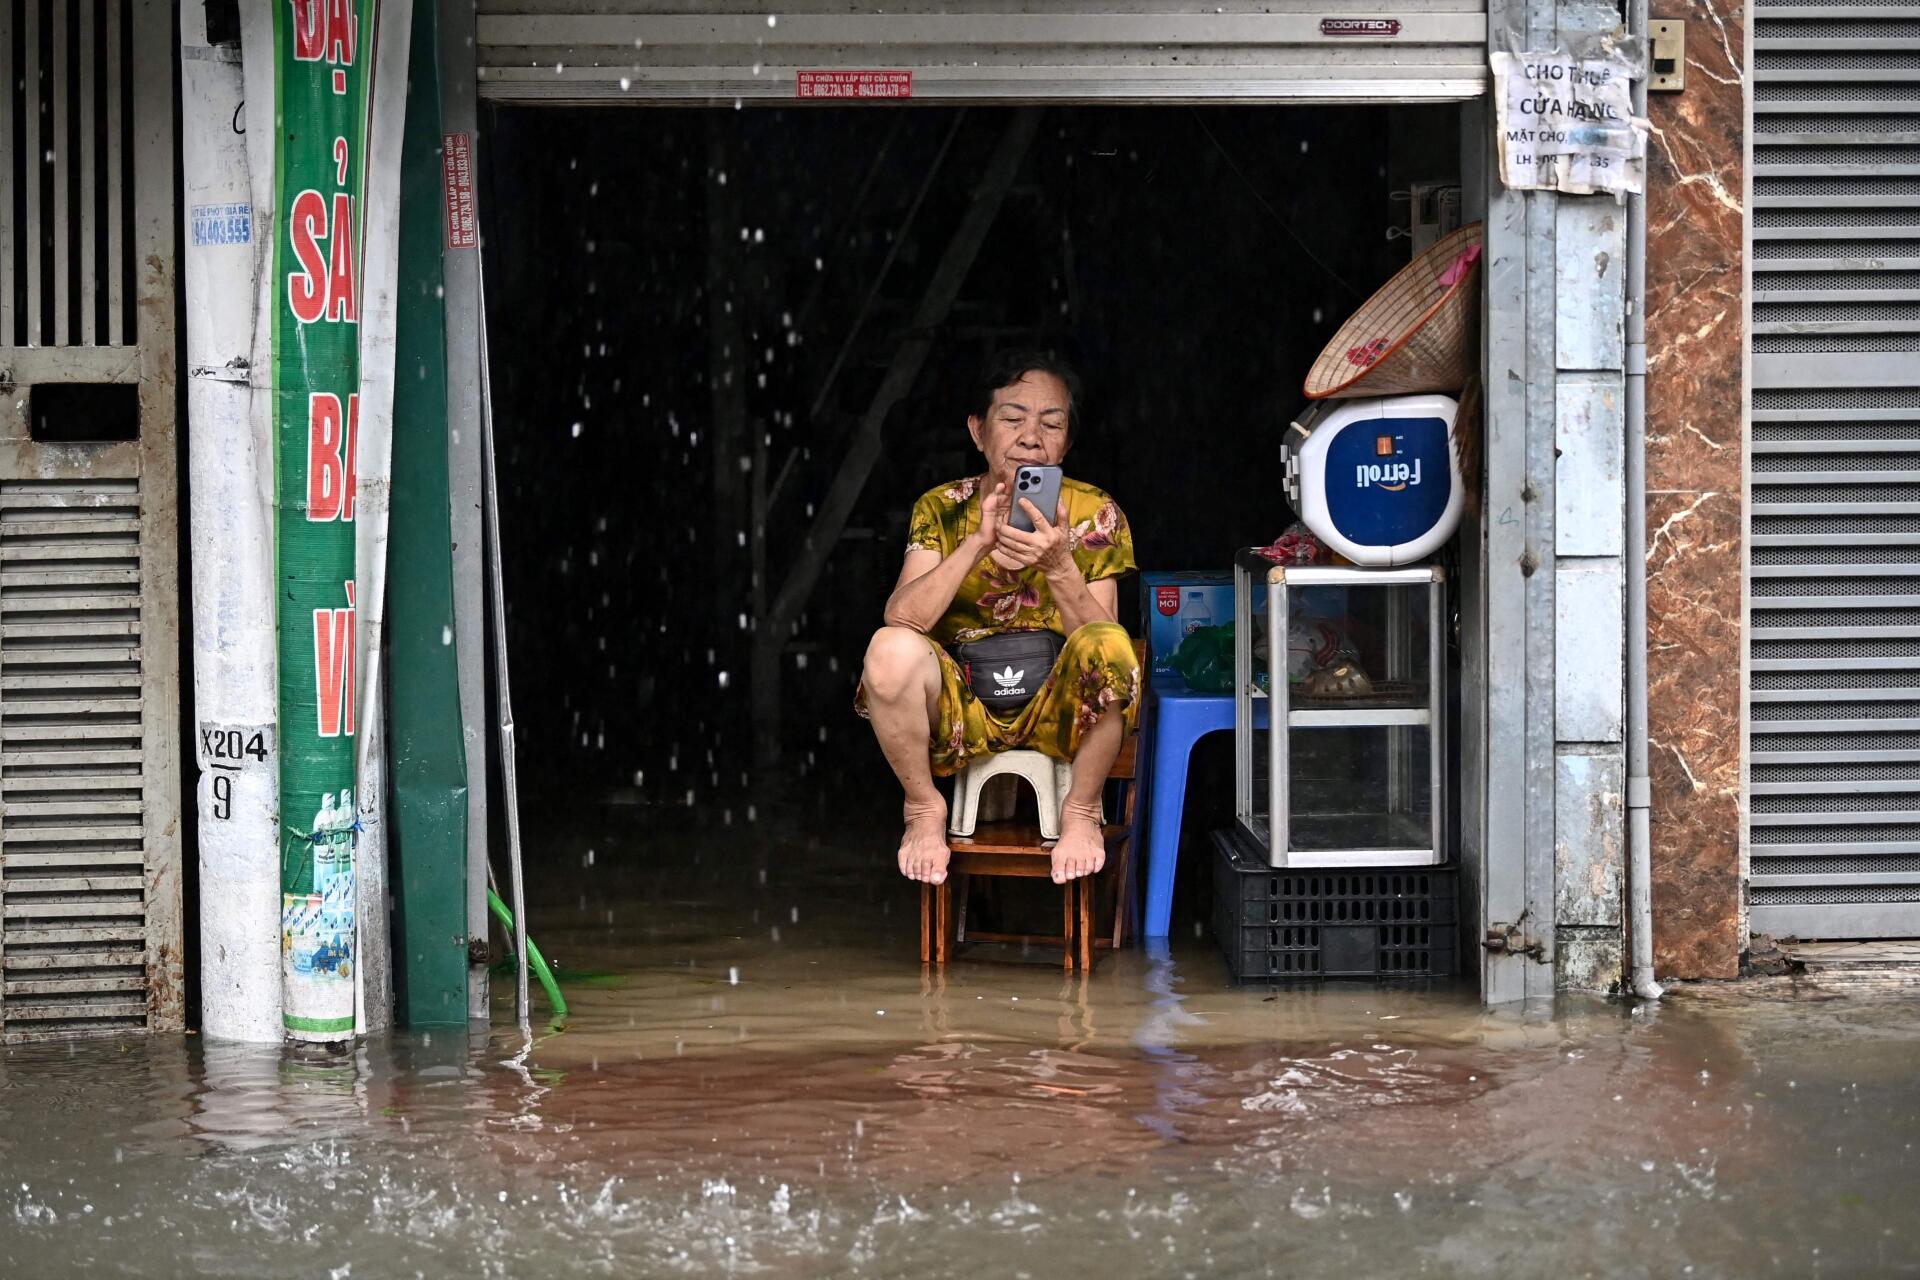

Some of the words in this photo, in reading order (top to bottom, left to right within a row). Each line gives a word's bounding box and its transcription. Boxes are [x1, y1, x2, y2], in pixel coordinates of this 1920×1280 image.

[1326, 21, 1391, 29] DOORTECH
[1525, 64, 1563, 80] CHO
[1520, 91, 1562, 115] CỬA
[1506, 128, 1535, 144] MẶT
[1356, 458, 1421, 487] Ferroli
[994, 687, 1026, 696] adidas
[202, 729, 268, 761] X204
[213, 776, 231, 820] 9
